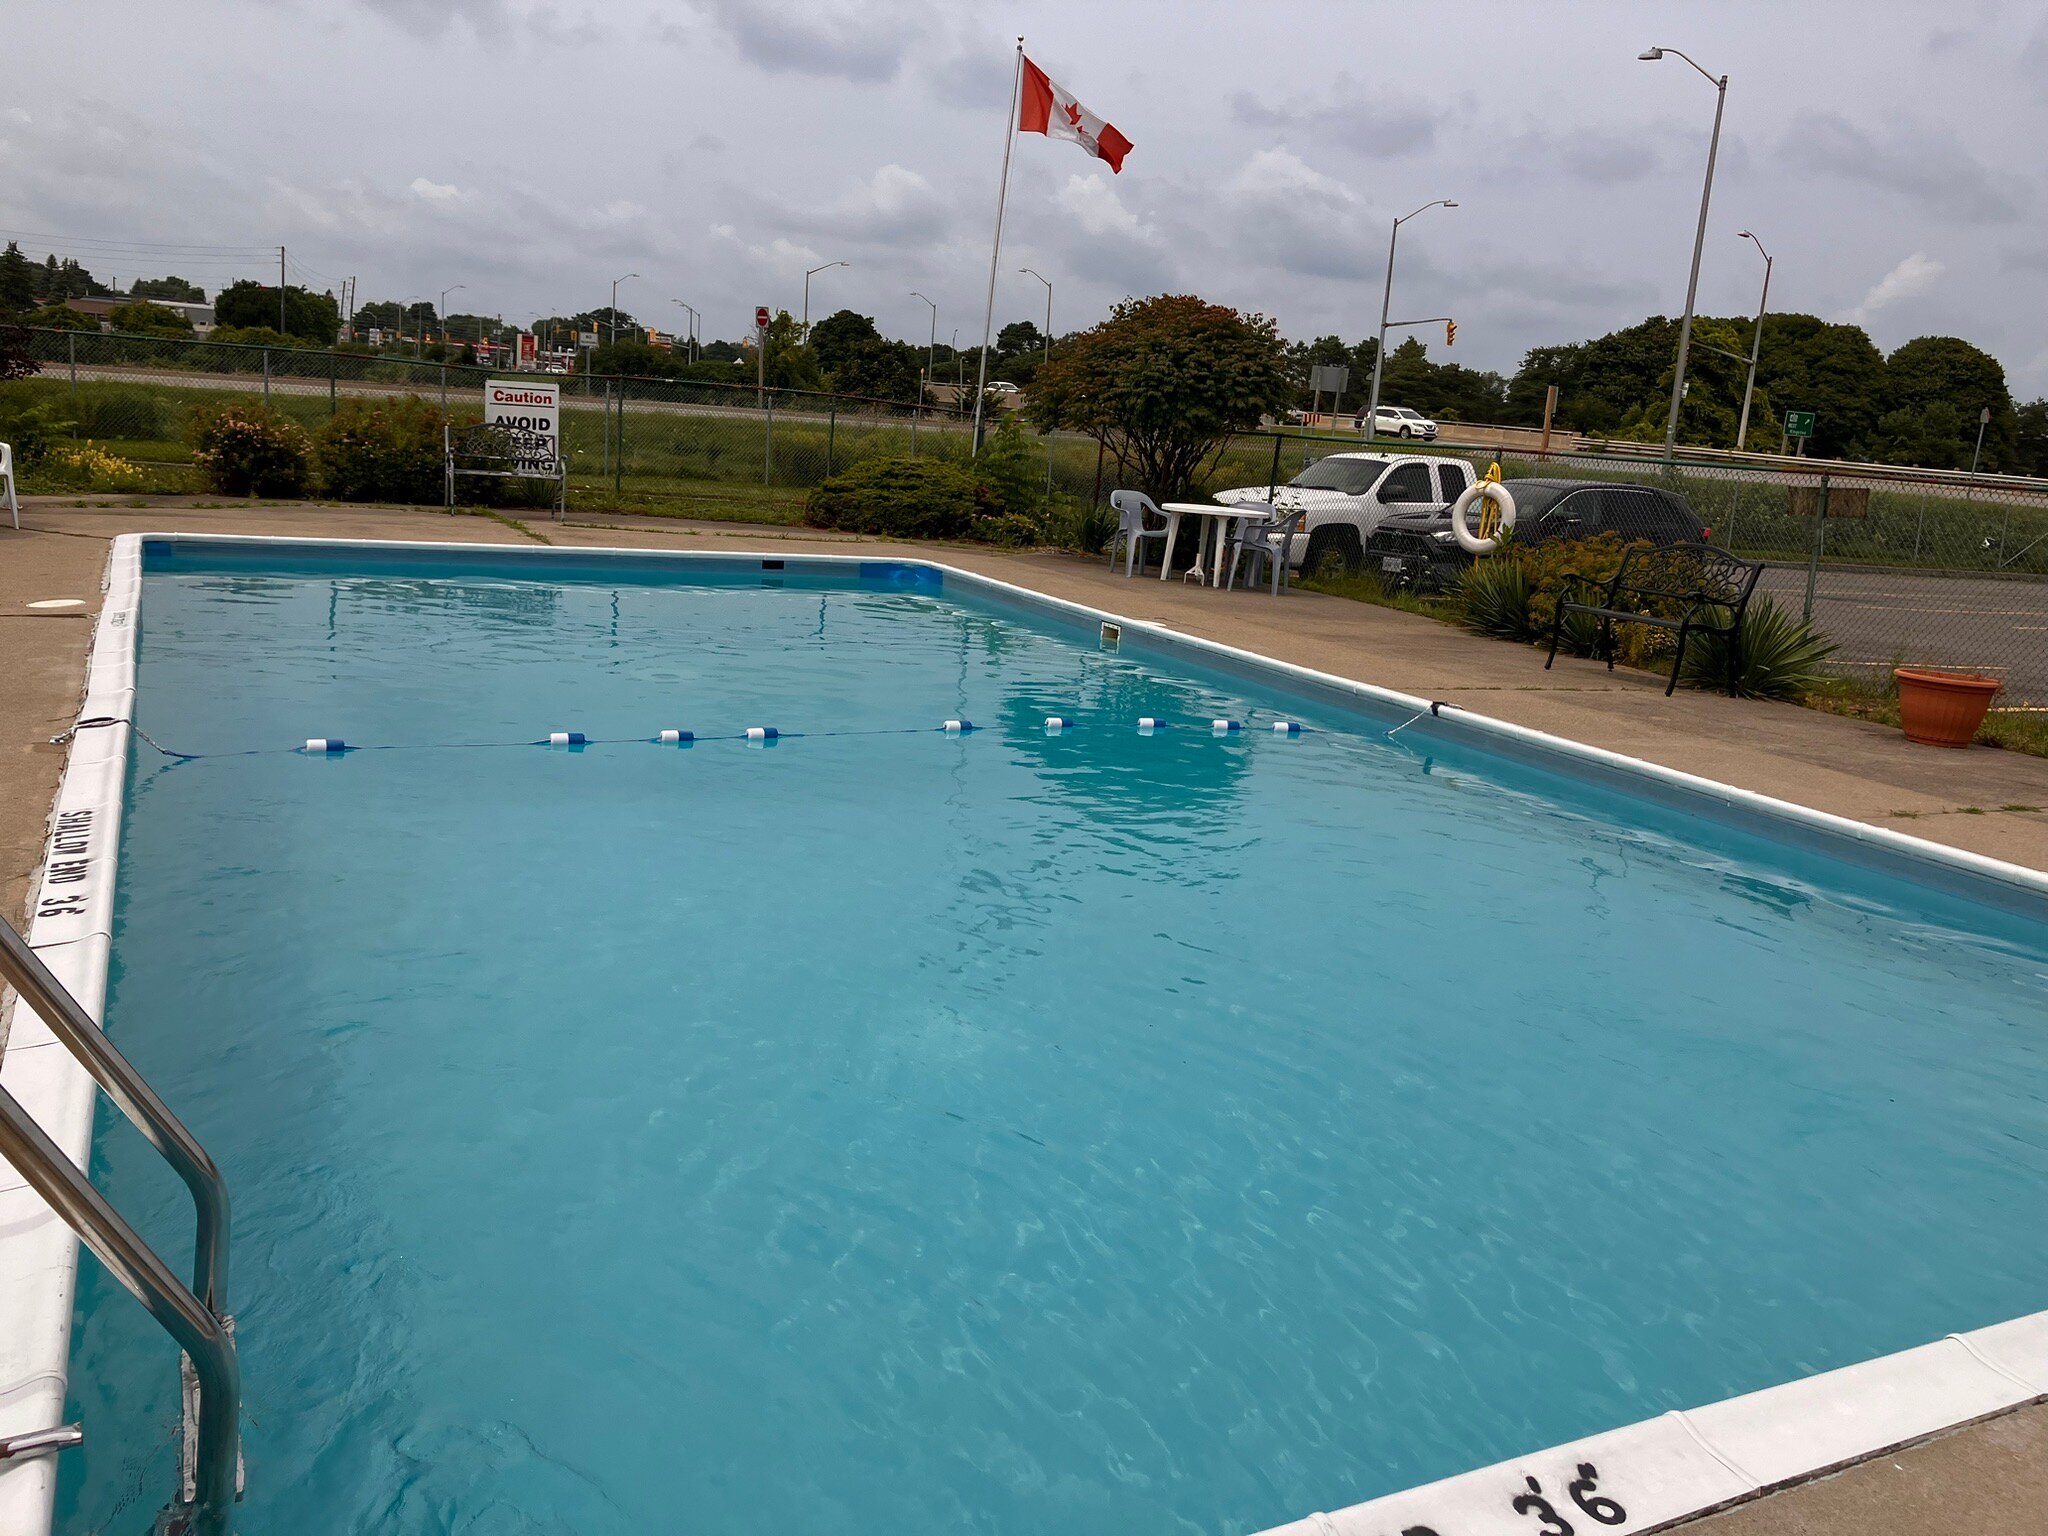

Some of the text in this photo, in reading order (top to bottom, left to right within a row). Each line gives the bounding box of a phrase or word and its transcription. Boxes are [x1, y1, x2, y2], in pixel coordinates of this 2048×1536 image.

[494, 390, 552, 404] Caution
[496, 415, 550, 431] AVOID
[512, 434, 547, 450] EEP
[48, 859, 94, 884] END
